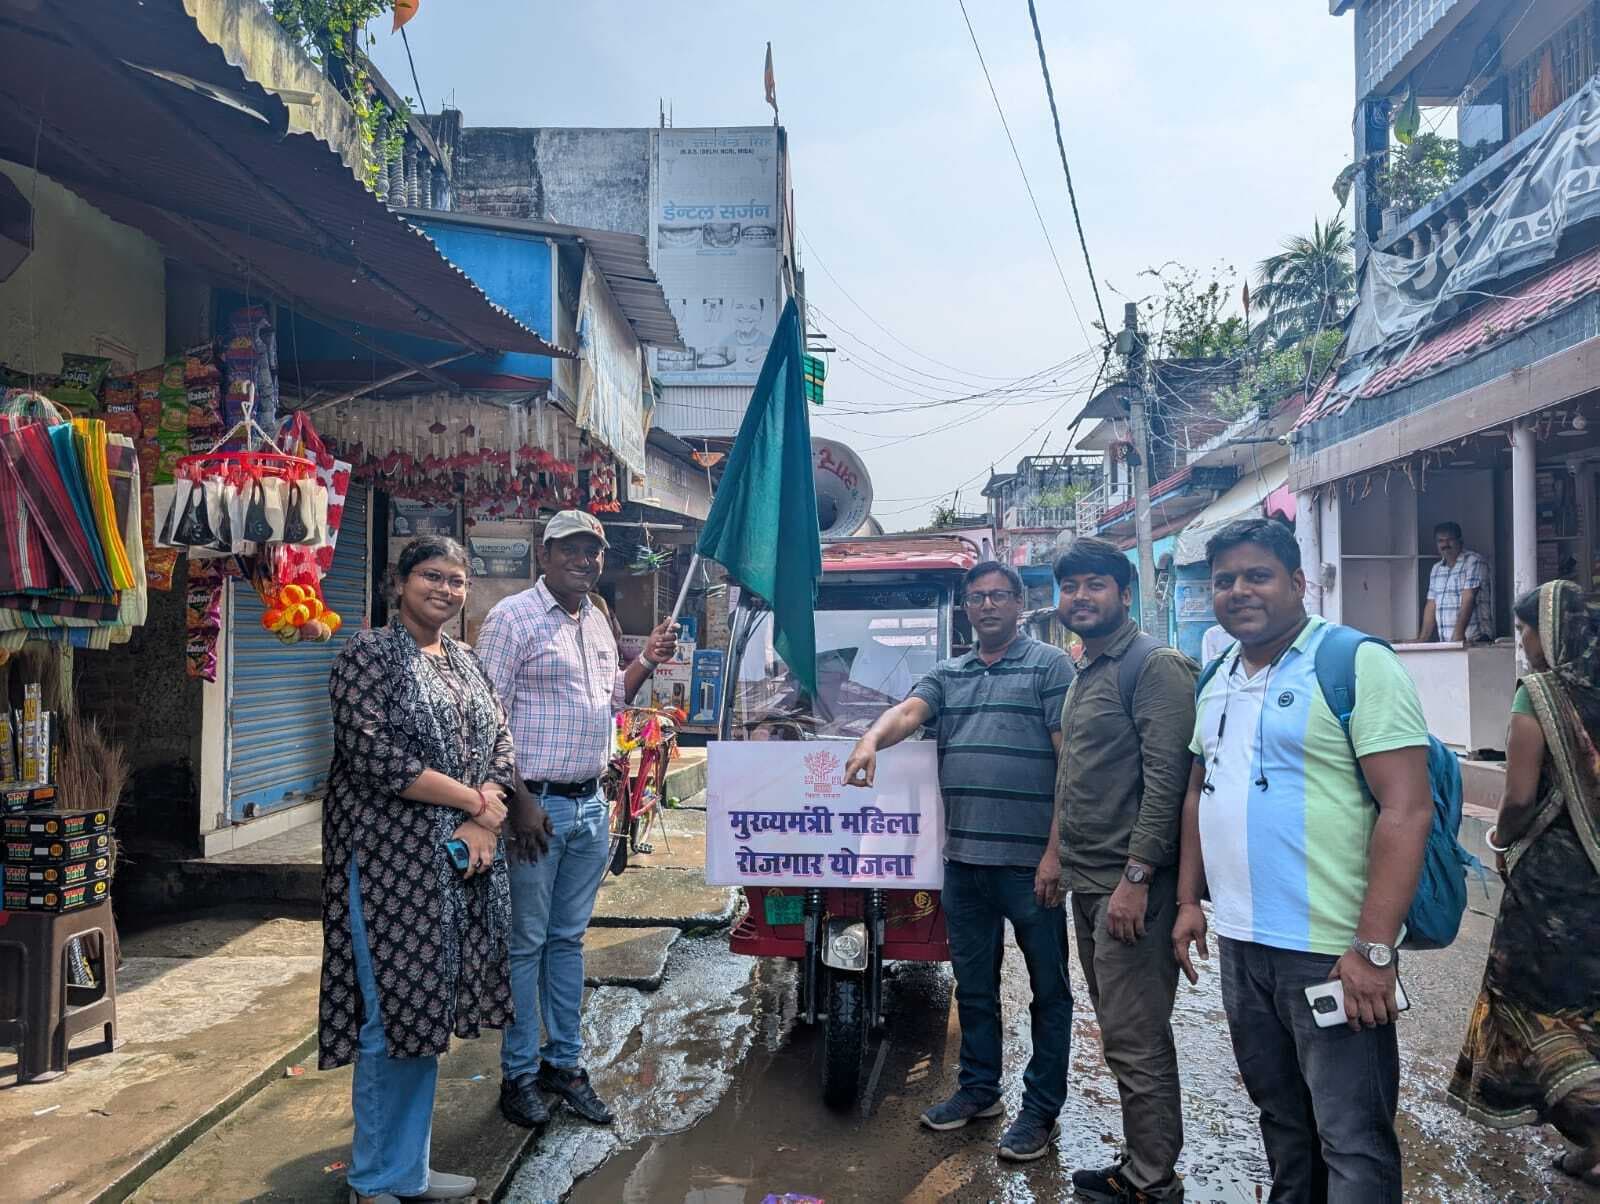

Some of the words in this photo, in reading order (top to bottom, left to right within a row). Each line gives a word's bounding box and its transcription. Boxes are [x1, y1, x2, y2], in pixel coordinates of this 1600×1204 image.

[663, 200, 716, 221] डेन्टल
[720, 199, 772, 219] सर्जन
[728, 806, 834, 839] मुख्यमंत्री
[839, 807, 921, 835] महिला
[735, 846, 824, 876] रोजगार
[828, 847, 914, 877] योजना
